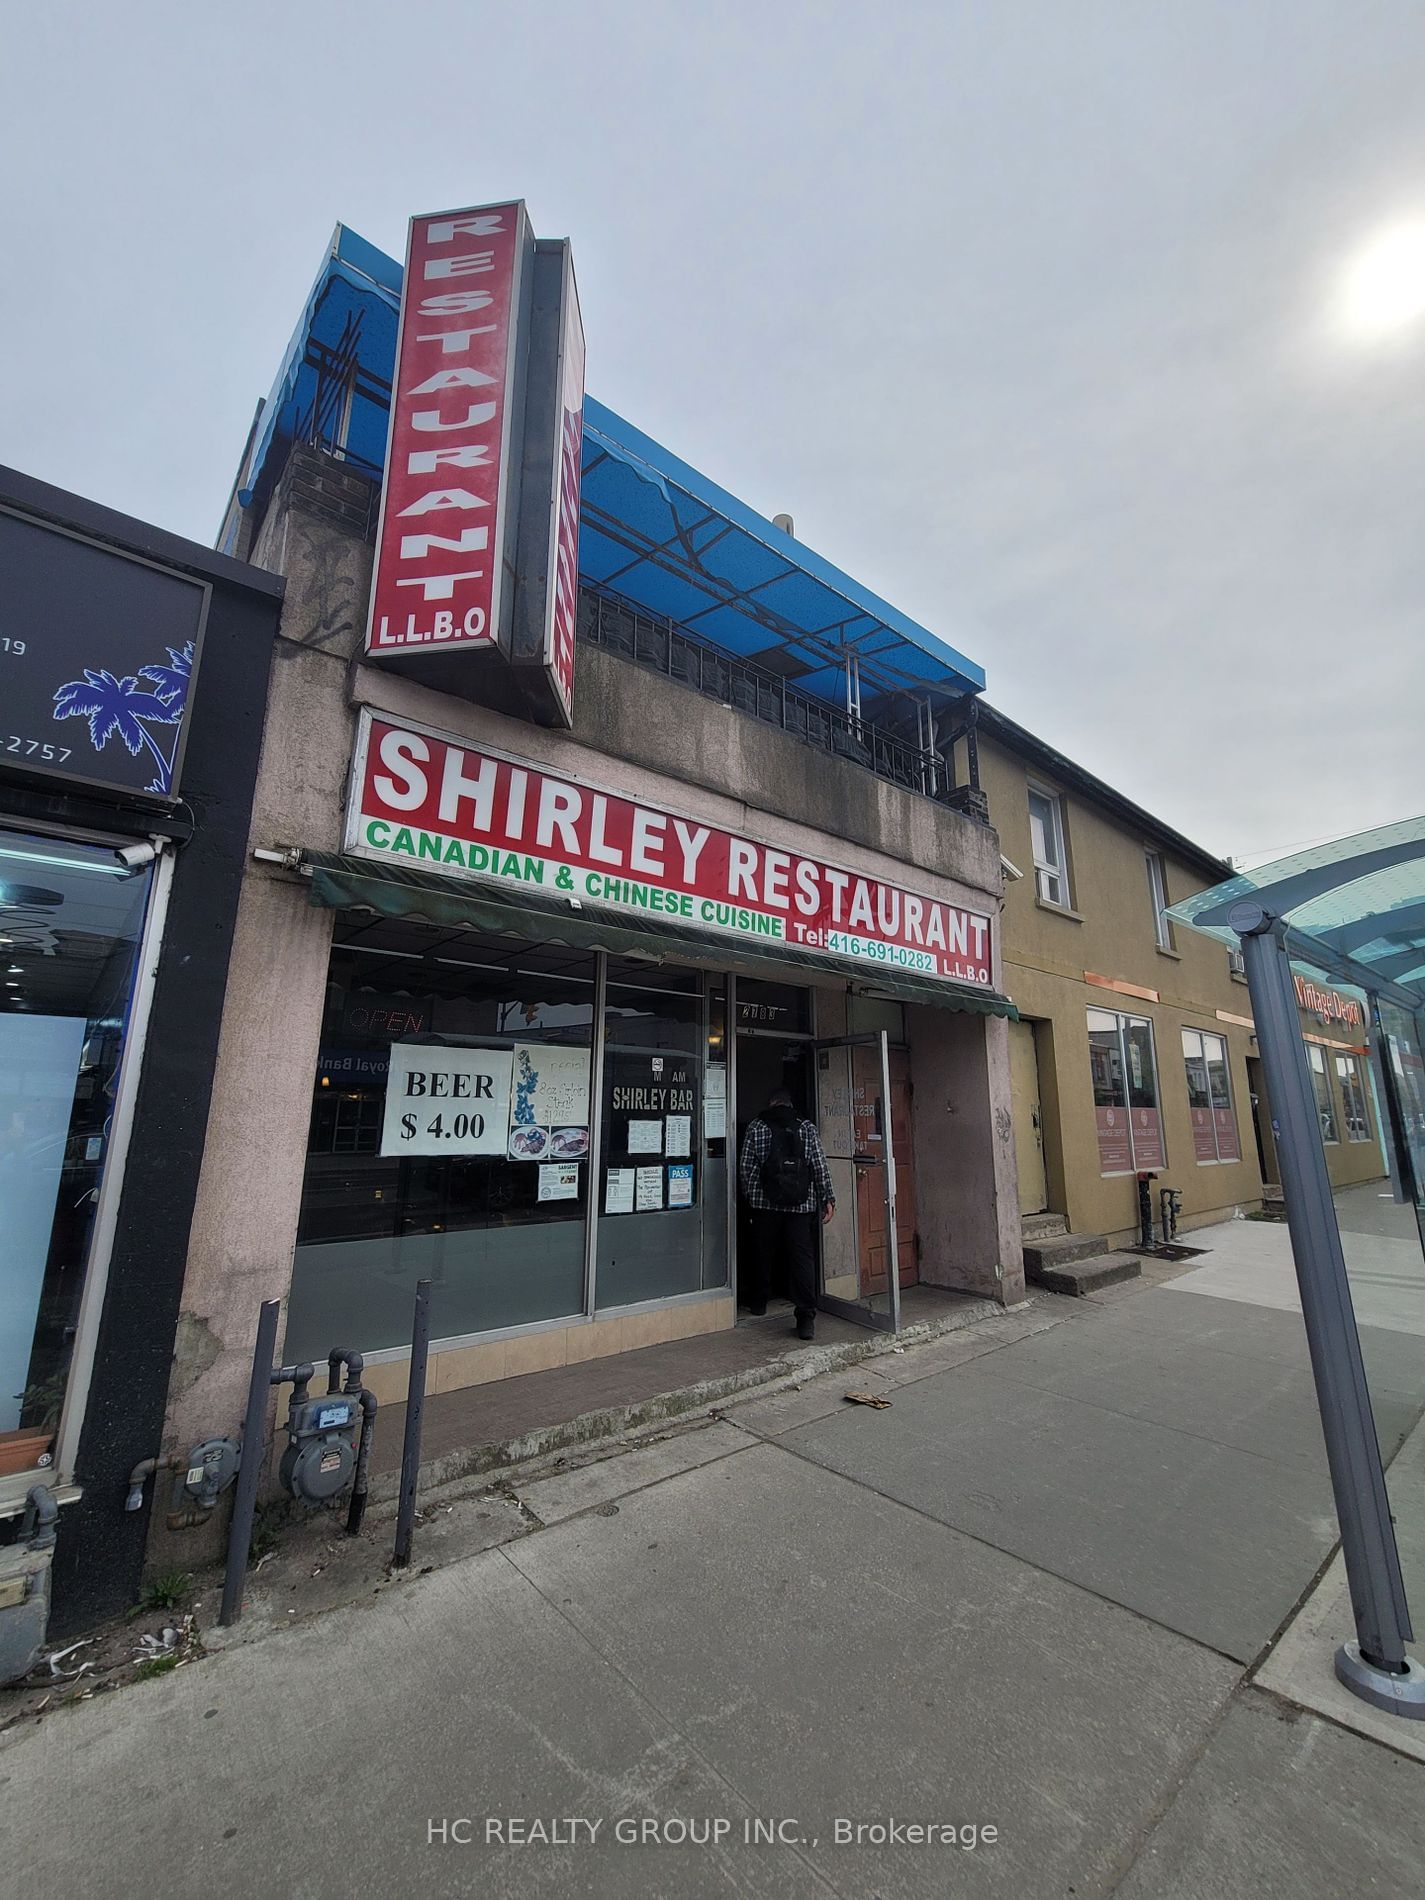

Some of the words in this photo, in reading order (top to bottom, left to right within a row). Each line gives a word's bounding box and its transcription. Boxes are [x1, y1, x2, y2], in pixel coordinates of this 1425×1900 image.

[396, 215, 507, 601] RESTAURANT
[379, 606, 486, 645] L.L.B.O
[373, 730, 711, 885] SHIRLEY
[728, 837, 990, 960] RESTAURANT
[366, 820, 544, 885] CANADIAN
[554, 865, 575, 890] &
[586, 872, 694, 918] CHINESE
[700, 900, 782, 938] CUISINE
[793, 922, 828, 947] Tel:
[829, 932, 933, 971] 416-691-0282
[943, 958, 989, 984] L.L.B.O
[350, 1008, 424, 1033] OPEN
[1294, 975, 1333, 1025] Vintage
[1332, 991, 1361, 1032] Depot
[404, 1071, 496, 1100] BEER
[612, 1086, 667, 1110] SHIRLEY
[670, 1088, 694, 1111] BAR
[400, 1112, 418, 1142] $
[427, 1112, 486, 1140] 4.00
[672, 1169, 690, 1179] PASS
